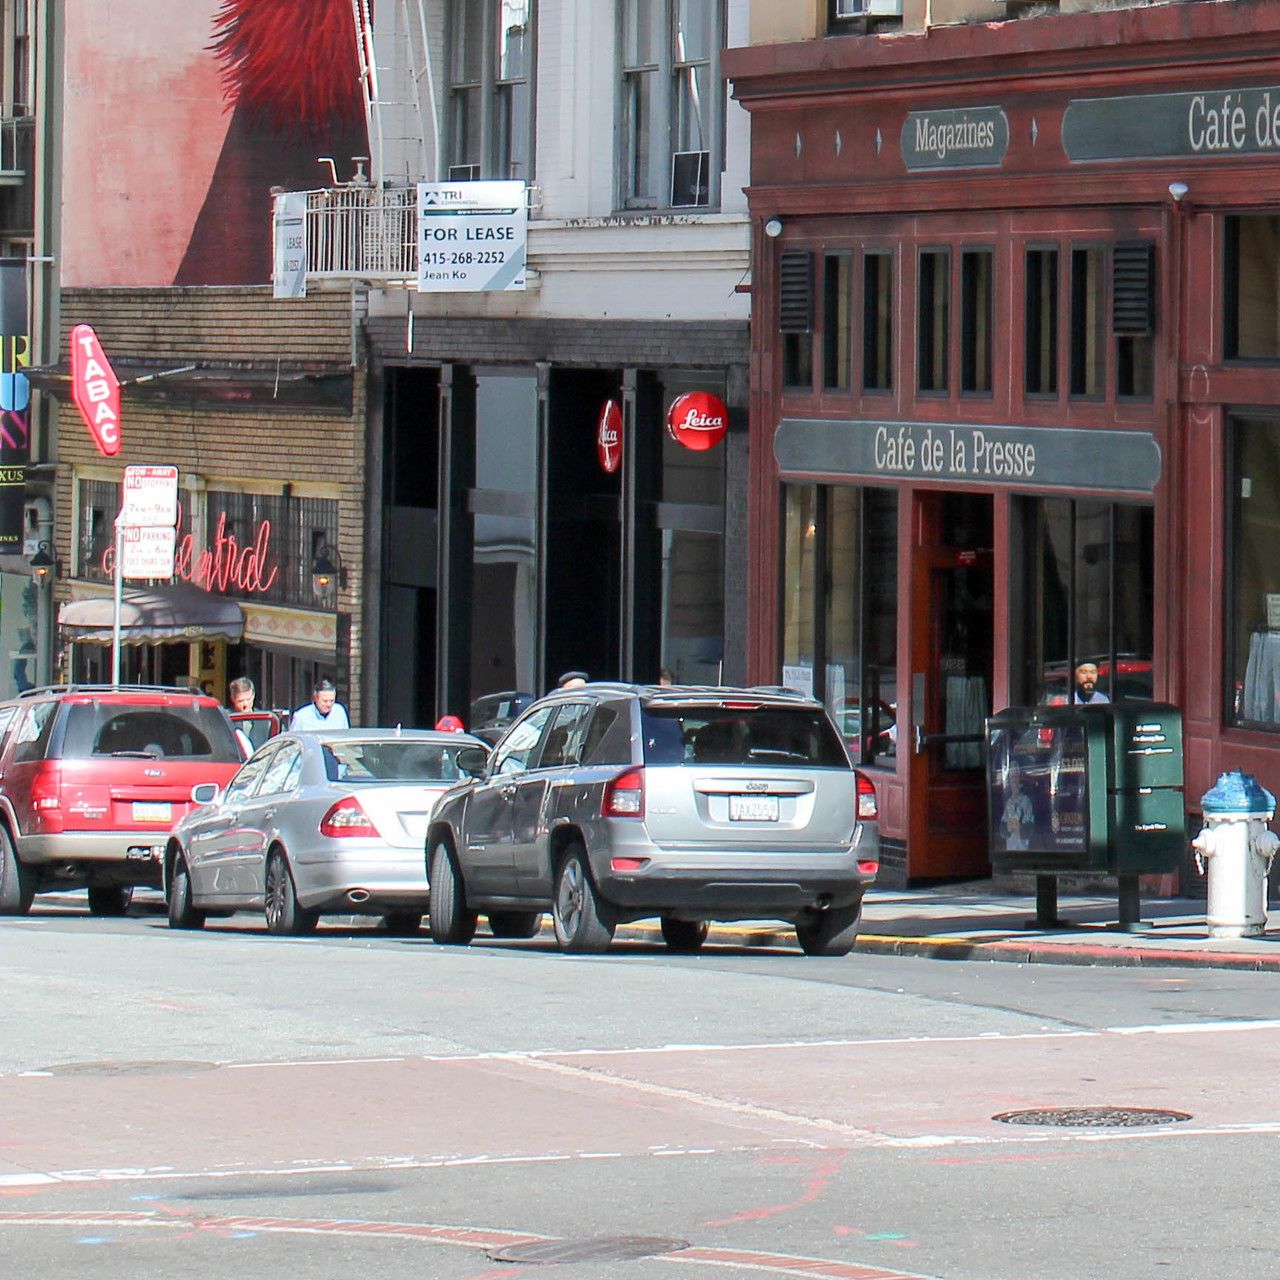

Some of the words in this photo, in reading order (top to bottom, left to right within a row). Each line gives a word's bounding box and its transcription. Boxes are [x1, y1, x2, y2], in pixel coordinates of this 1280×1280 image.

[1188, 93, 1247, 151] Café
[915, 116, 995, 159] Magazines
[442, 190, 462, 200] TRI
[424, 228, 458, 241] FOR
[466, 226, 515, 241] LEASE
[423, 251, 505, 265] 415-268-2252
[423, 271, 450, 280] Jean
[452, 270, 467, 280] Ko
[78, 335, 118, 444] TABAC
[680, 408, 724, 431] Leica
[874, 426, 916, 471] Café
[920, 428, 944, 472] de
[949, 429, 967, 473] la
[972, 430, 1036, 477] Presse
[0, 469, 24, 481] XUS
[127, 476, 142, 489] NO
[125, 527, 141, 542] NO
[143, 531, 172, 542] PARKING
[173, 499, 278, 592] entral
